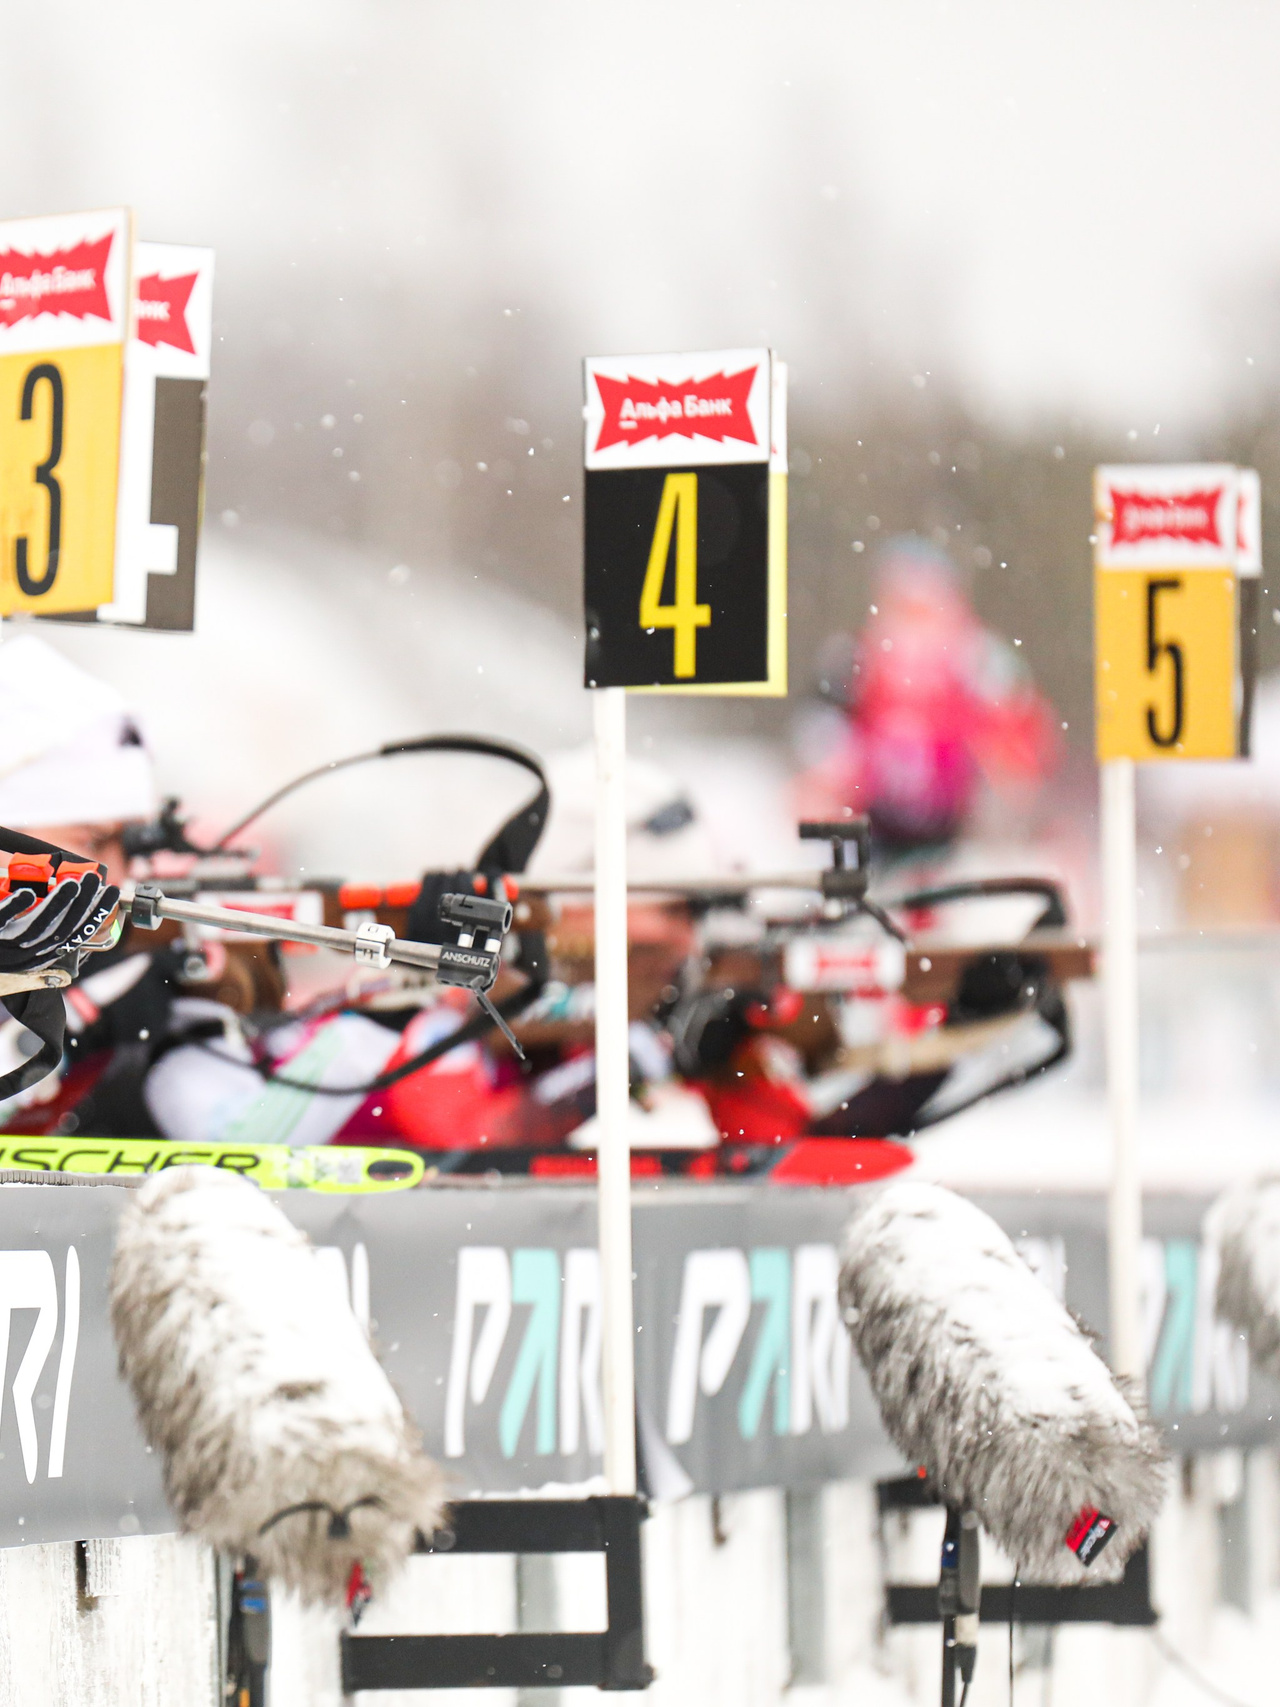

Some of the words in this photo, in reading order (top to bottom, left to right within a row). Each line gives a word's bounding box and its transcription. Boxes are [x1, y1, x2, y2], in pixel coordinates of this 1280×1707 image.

[13, 362, 65, 597] 3
[619, 396, 683, 429] Альфа
[683, 395, 732, 418] Банк
[639, 472, 711, 678] 4
[1147, 578, 1183, 748] 5
[61, 908, 109, 952] MOAX
[442, 951, 491, 967] ANSCHUTZ
[444, 1246, 606, 1460] PAR
